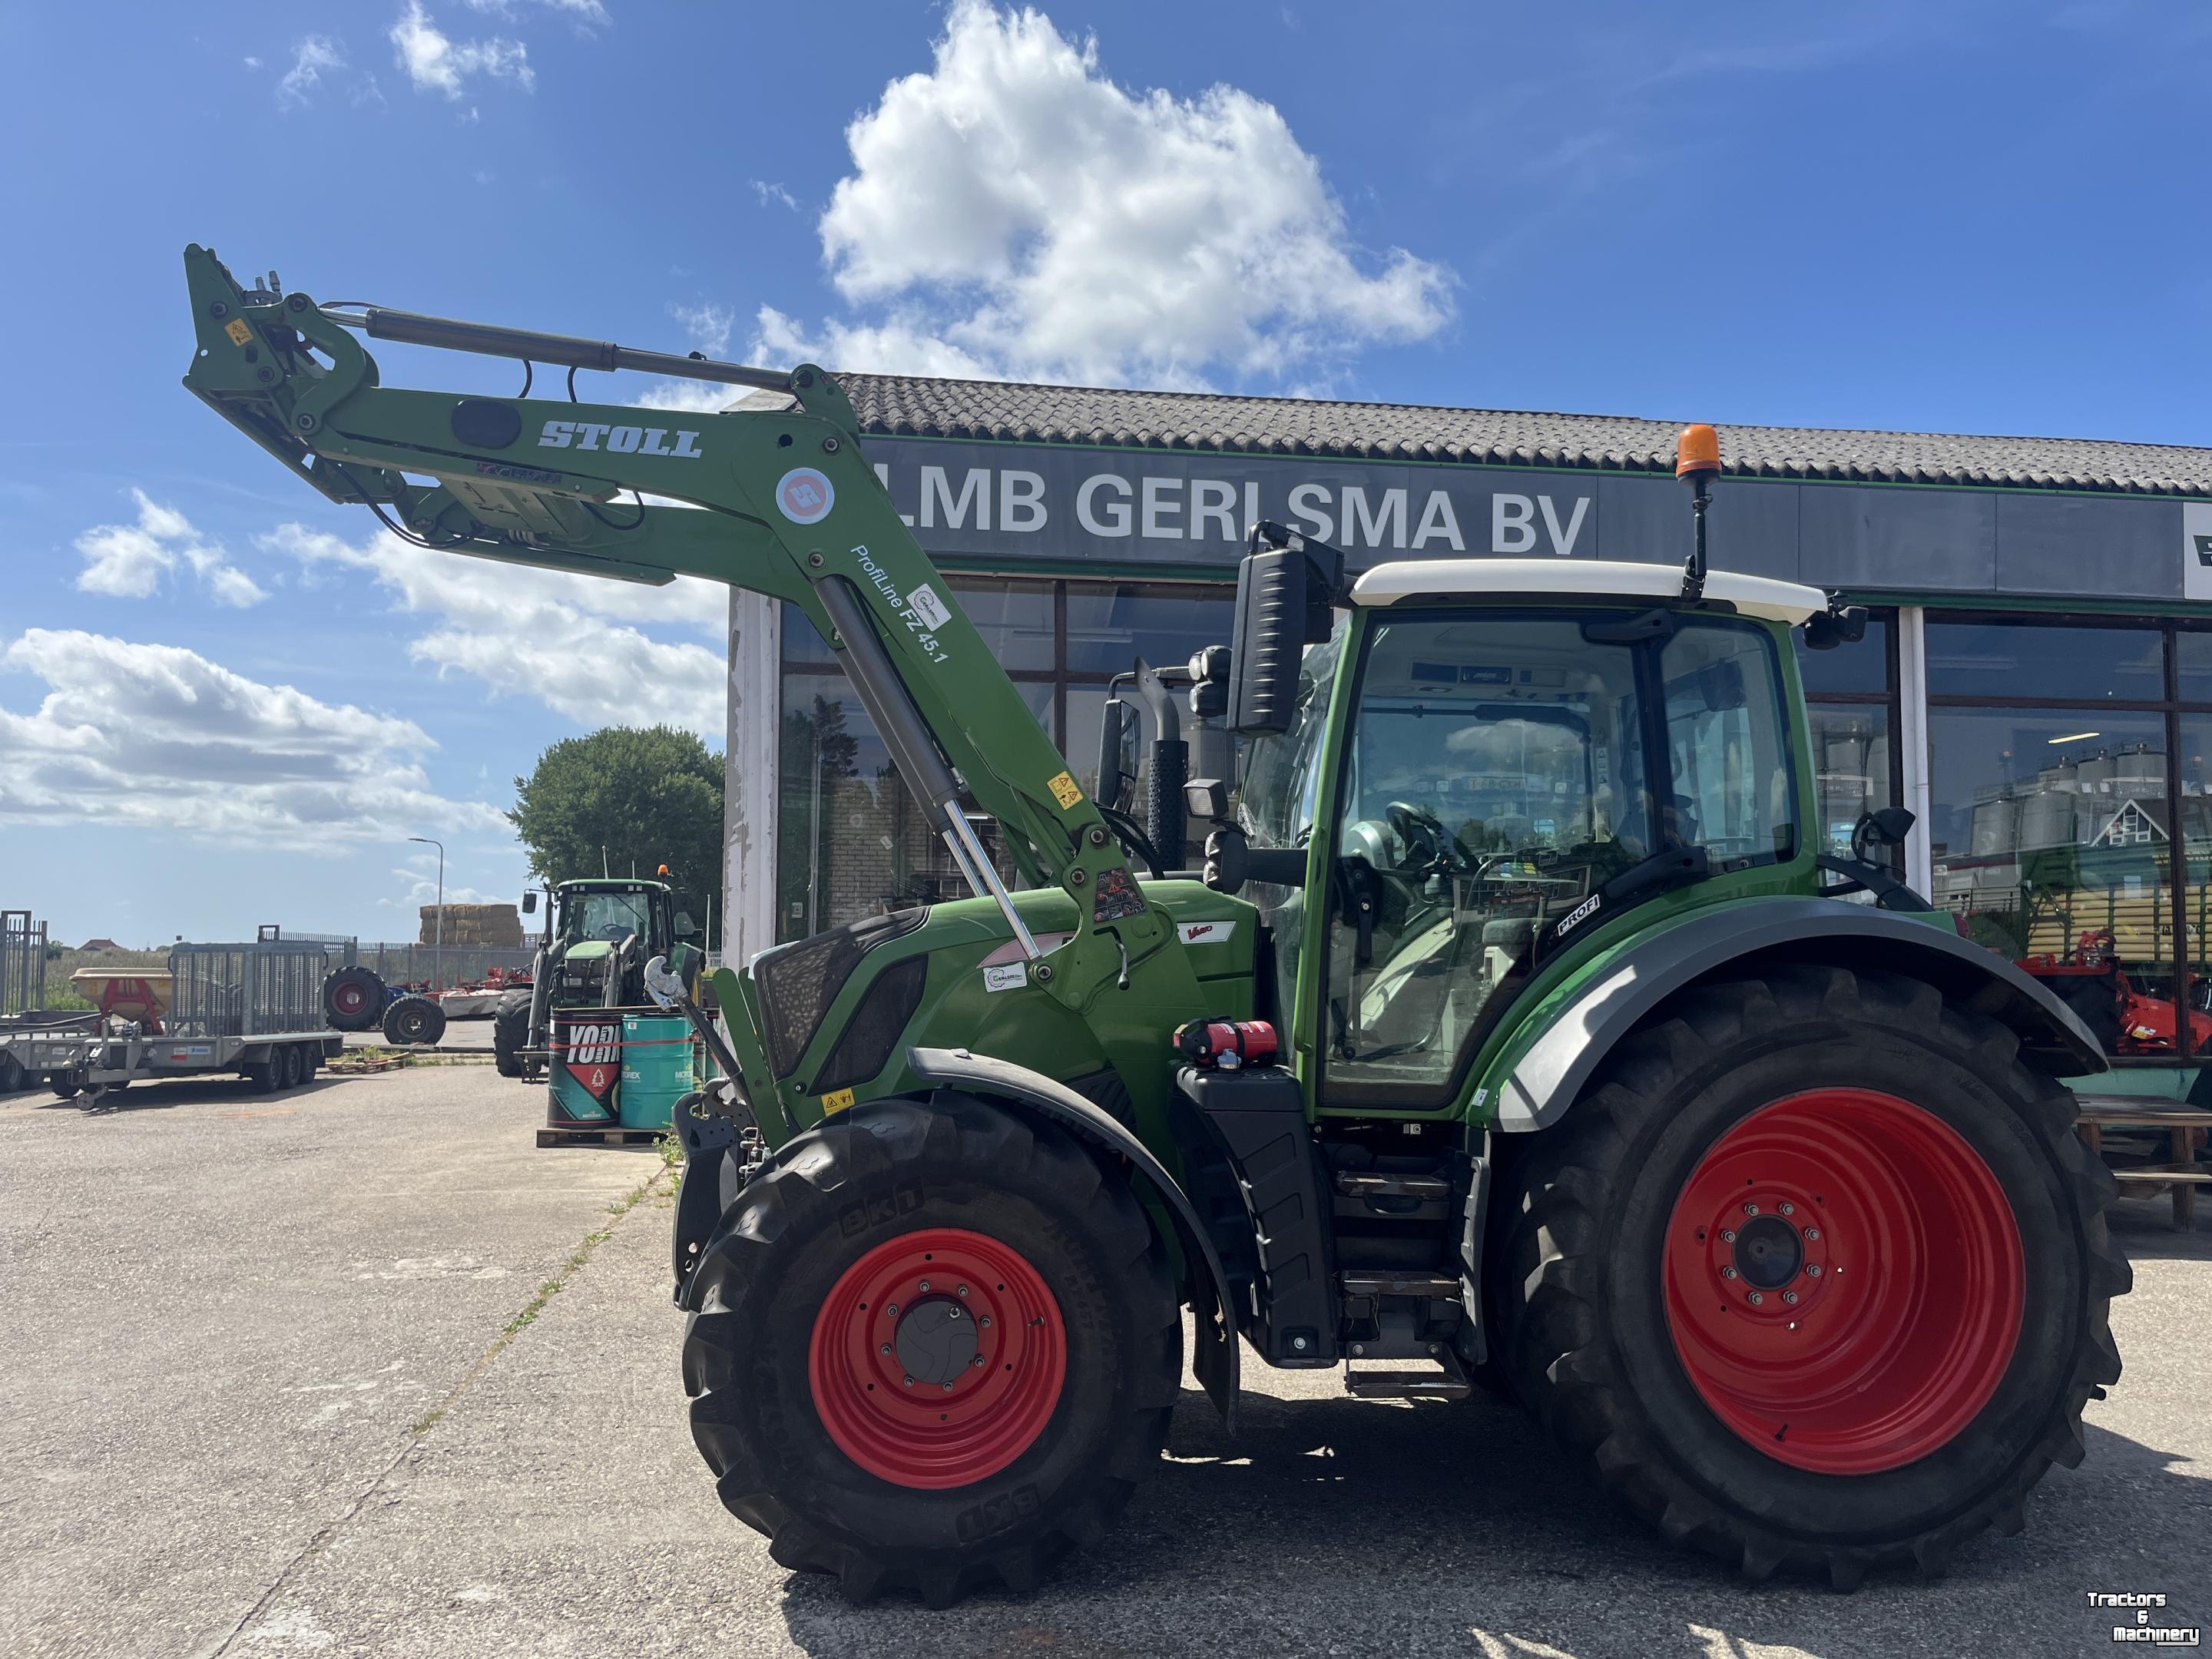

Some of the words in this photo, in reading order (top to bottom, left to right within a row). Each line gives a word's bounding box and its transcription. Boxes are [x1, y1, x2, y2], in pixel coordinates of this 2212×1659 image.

[538, 421, 702, 459] STOLL
[874, 463, 1048, 533] MB
[1076, 474, 1466, 551] GERLSMA
[1492, 493, 1591, 555] BV
[850, 545, 902, 608] ProfiLine
[899, 608, 924, 632] FZ
[919, 634, 949, 663] 45.1
[1558, 896, 1598, 933] PROFI
[842, 1184, 923, 1236] BKT
